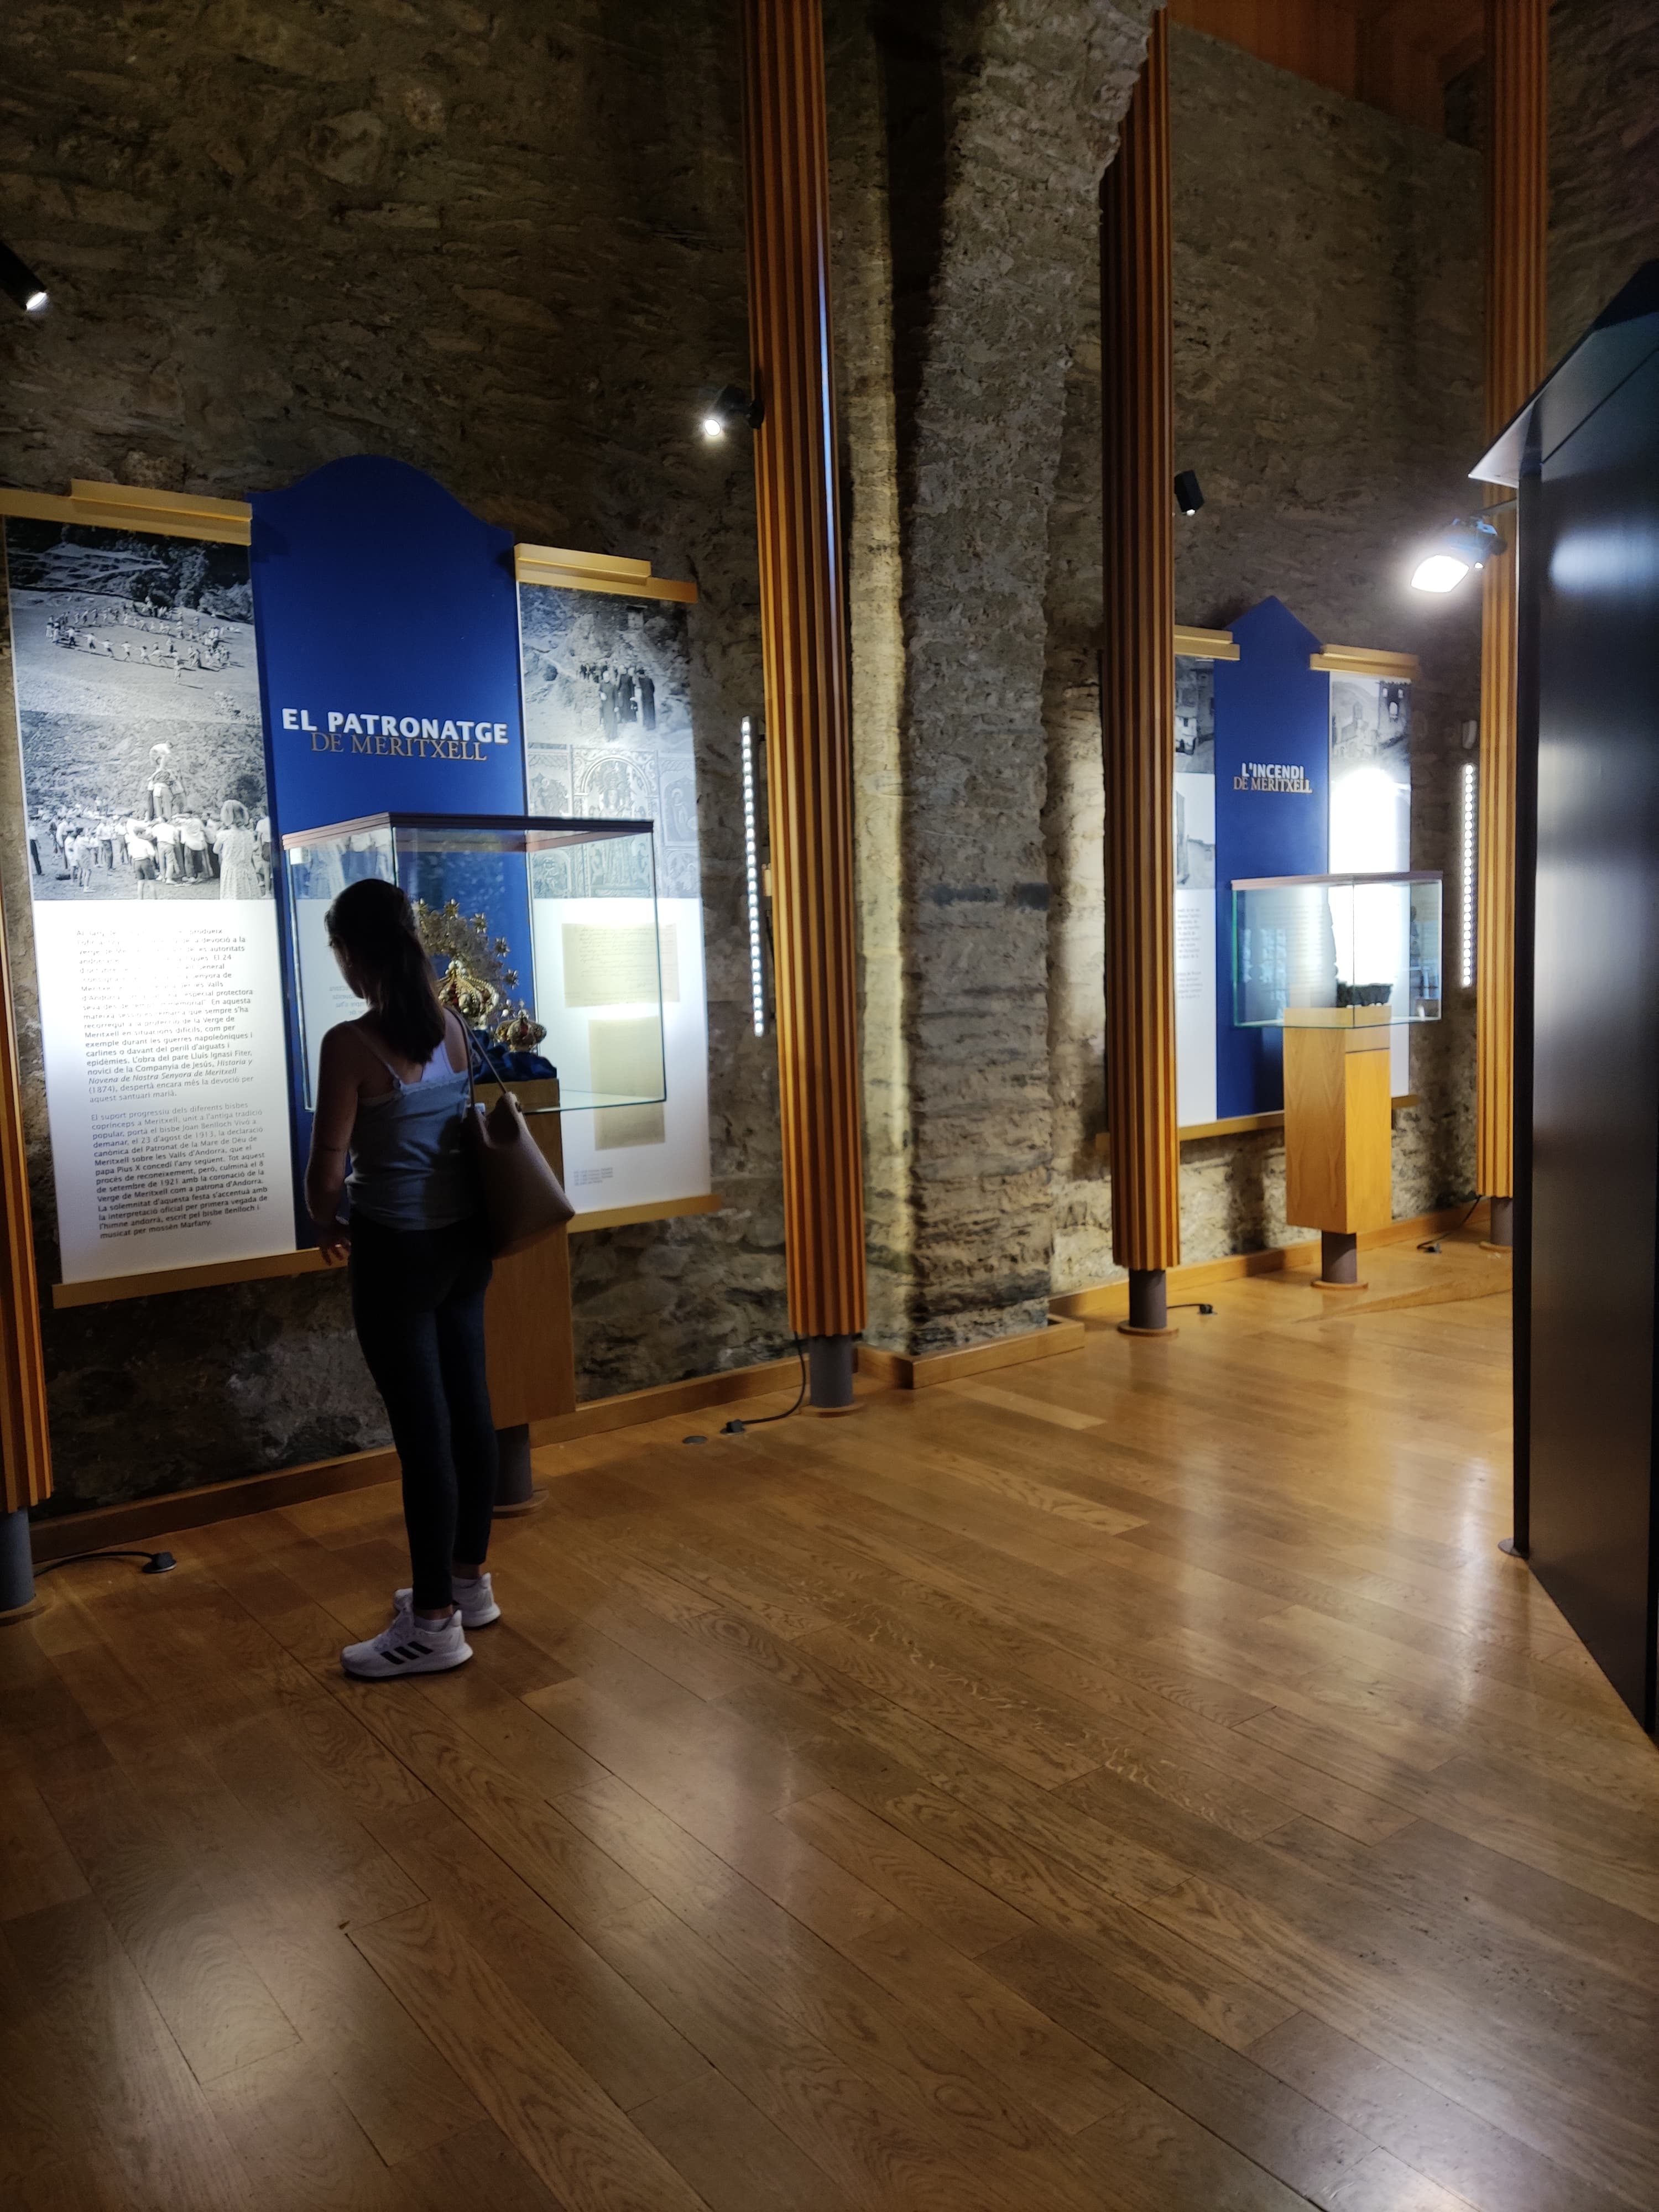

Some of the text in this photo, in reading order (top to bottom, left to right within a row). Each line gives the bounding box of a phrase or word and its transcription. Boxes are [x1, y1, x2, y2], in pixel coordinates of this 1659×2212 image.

[282, 708, 508, 743] EL PATRONATGE
[311, 732, 487, 761] DE MERITXELL
[1241, 763, 1304, 779] L'INCENDI
[1233, 776, 1312, 793] DE MERITXELL
[126, 1046, 153, 1054] davant
[170, 1044, 189, 1052] perill
[191, 1041, 225, 1050] d'aiguats
[163, 1036, 191, 1044] guerres
[210, 1050, 232, 1058] Ignasi
[87, 1067, 111, 1075] novici
[135, 1062, 178, 1072] Companyia
[205, 1067, 237, 1075] Meritxell
[89, 1093, 116, 1103] aquest
[118, 1091, 150, 1099] santuari
[100, 1111, 126, 1120] suport
[128, 1108, 169, 1118] progressiu
[189, 1103, 222, 1112] diferents
[235, 1108, 262, 1117] tradició
[153, 1133, 180, 1142] d'agost
[226, 1125, 263, 1135] declaració
[145, 1142, 177, 1151] Patronat
[94, 1156, 129, 1166] Meritxell
[95, 1167, 114, 1176] papa
[241, 1151, 264, 1160] aquest
[109, 1182, 145, 1191] setembre
[160, 1177, 178, 1186] 1921
[181, 1175, 198, 1183] amb
[208, 1170, 244, 1180] coronació
[134, 1187, 168, 1197] Meritxell
[195, 1182, 223, 1192] patrona
[108, 1207, 158, 1219] interpretació
[160, 1204, 182, 1213] oficial
[200, 1199, 228, 1209] primera
[231, 1196, 257, 1204] vegada
[109, 1199, 150, 1210] solemnitat
[153, 1195, 189, 1205] d'aquesta
[191, 1192, 210, 1201] festa
[99, 1220, 128, 1229] l'himne
[165, 1212, 186, 1221] escrit
[189, 1211, 200, 1219] pel
[202, 1208, 222, 1217] bisbe
[100, 1228, 131, 1238] musicat
[133, 1227, 146, 1235] per
